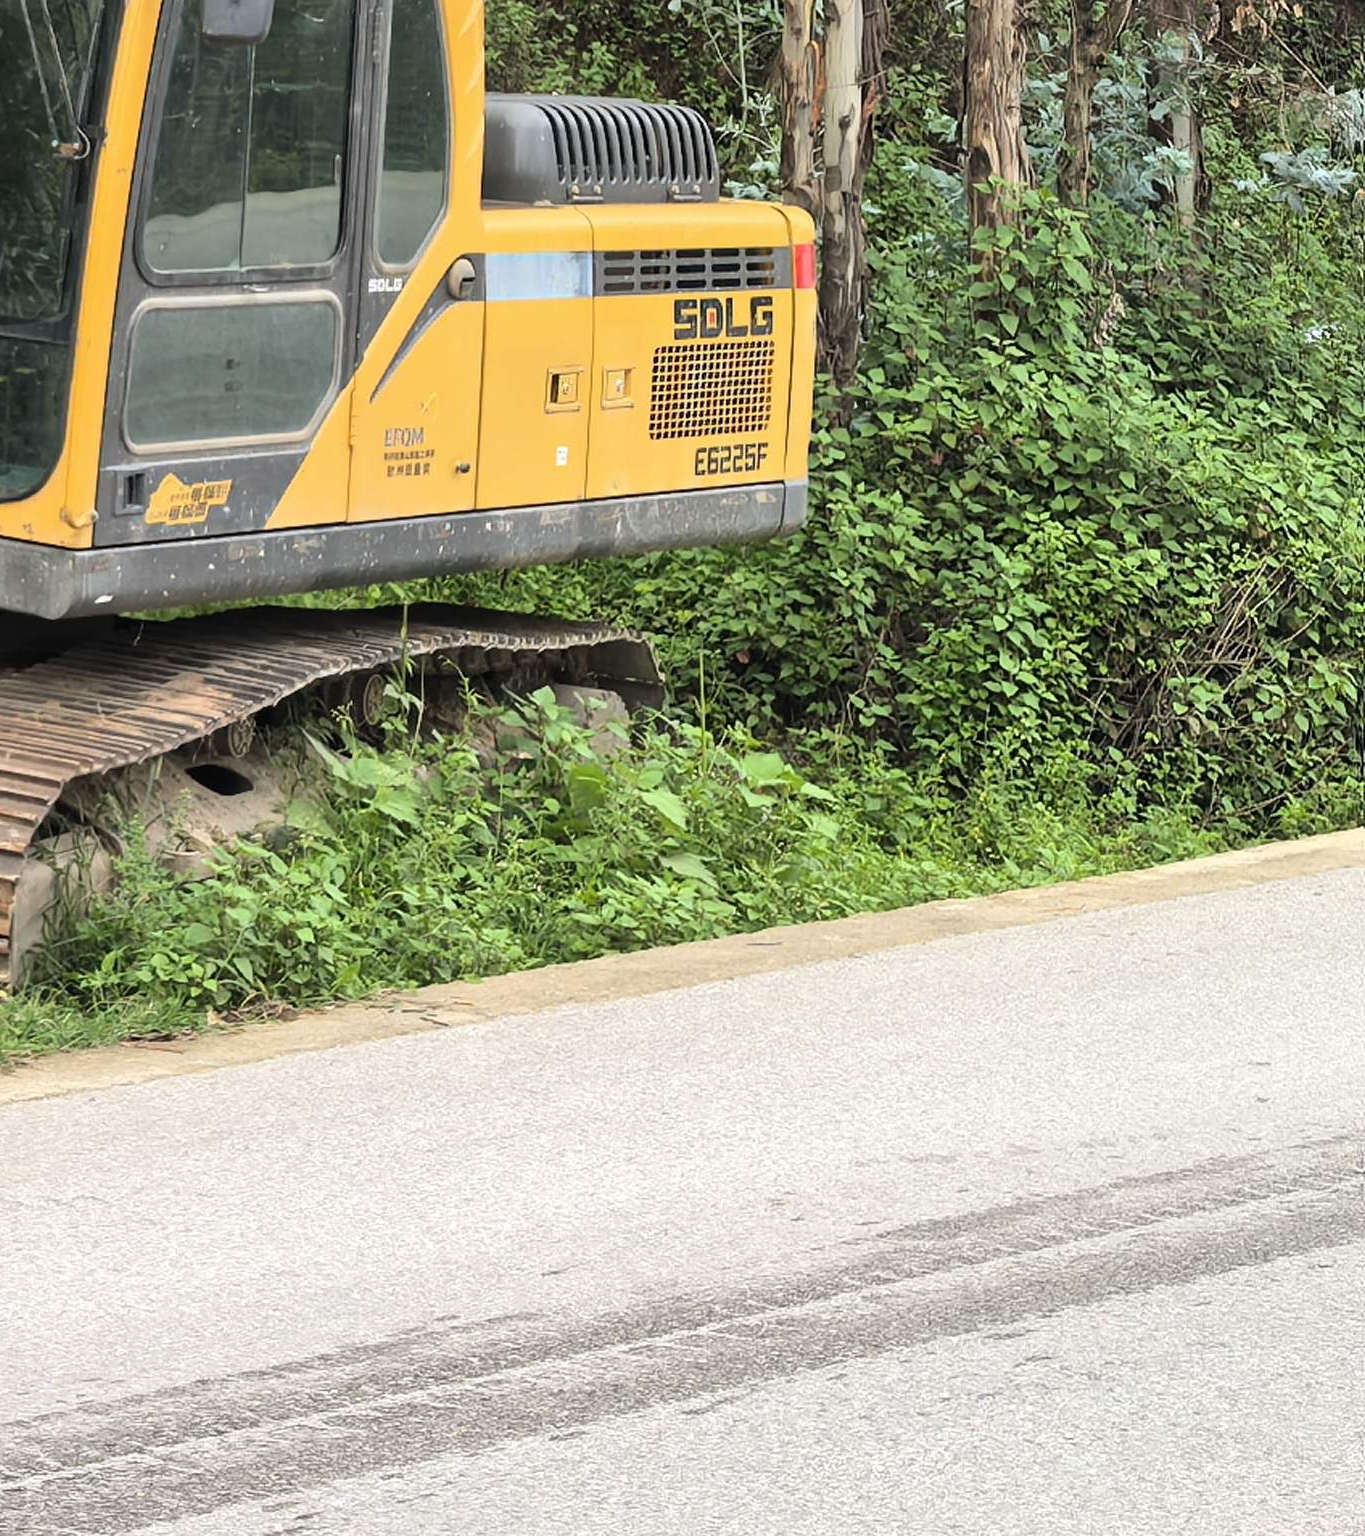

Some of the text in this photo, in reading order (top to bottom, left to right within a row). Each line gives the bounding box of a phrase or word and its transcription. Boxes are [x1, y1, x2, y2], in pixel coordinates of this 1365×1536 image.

[368, 277, 403, 292] SDLG
[673, 295, 774, 340] SDLG
[695, 442, 769, 476] E6225F
